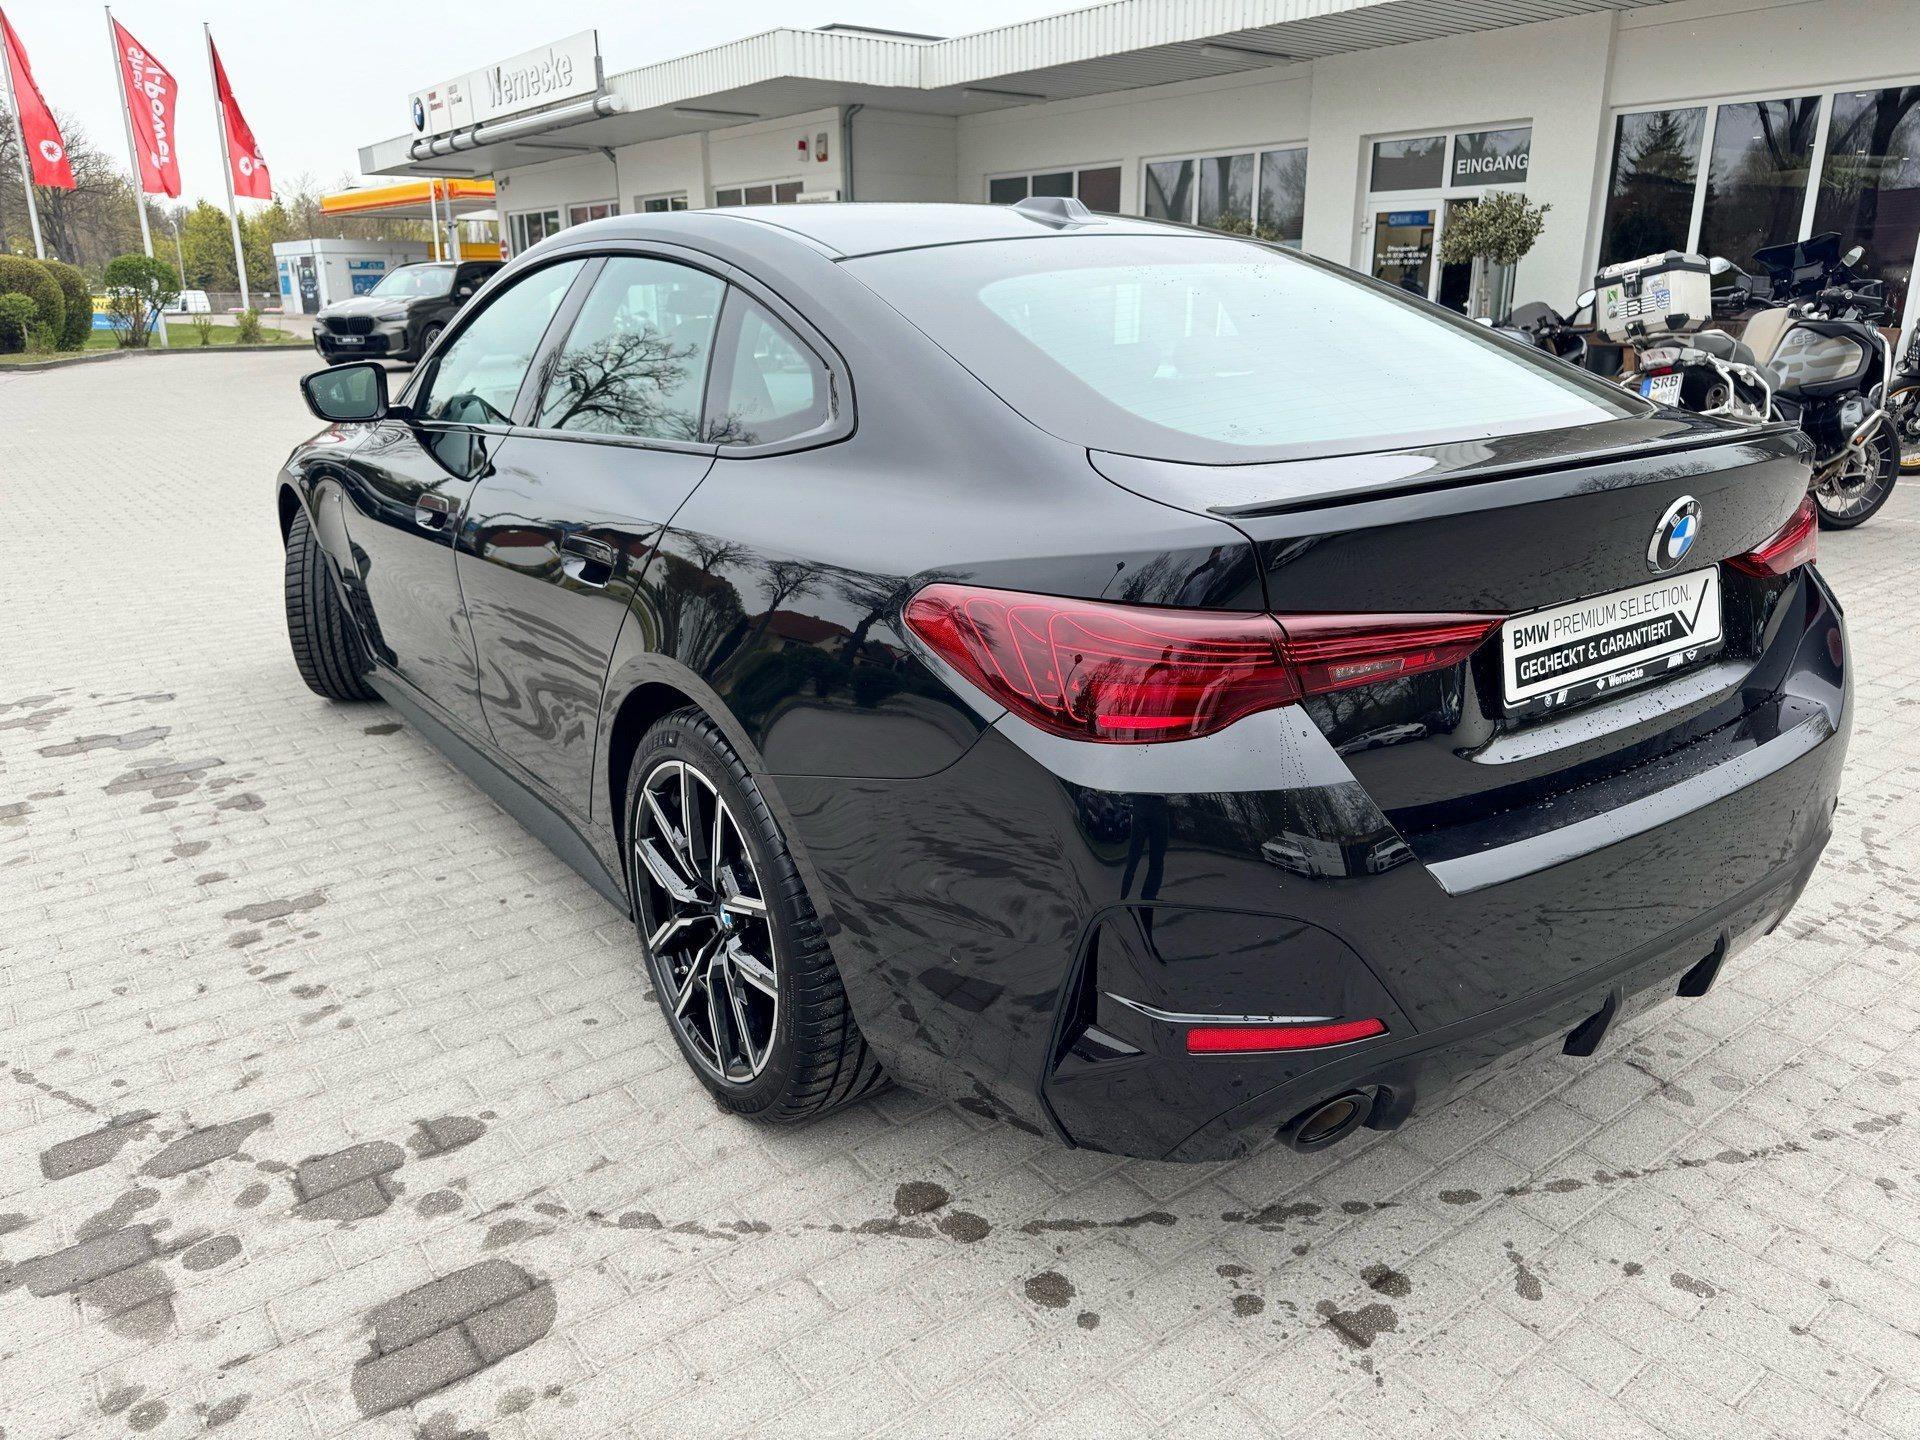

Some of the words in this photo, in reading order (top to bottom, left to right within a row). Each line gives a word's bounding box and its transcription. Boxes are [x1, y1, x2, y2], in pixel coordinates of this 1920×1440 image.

[485, 47, 573, 108] Wernecke
[1457, 154, 1529, 175] EINGANG
[1652, 376, 1679, 390] SRB
[1513, 621, 1550, 649] BMW
[1554, 604, 1617, 638] PREMIUM
[1520, 645, 1586, 680] GECHECKT
[1588, 641, 1598, 658] &
[1600, 620, 1673, 656] GARANTIERT
[1608, 667, 1644, 687] Wernecke
